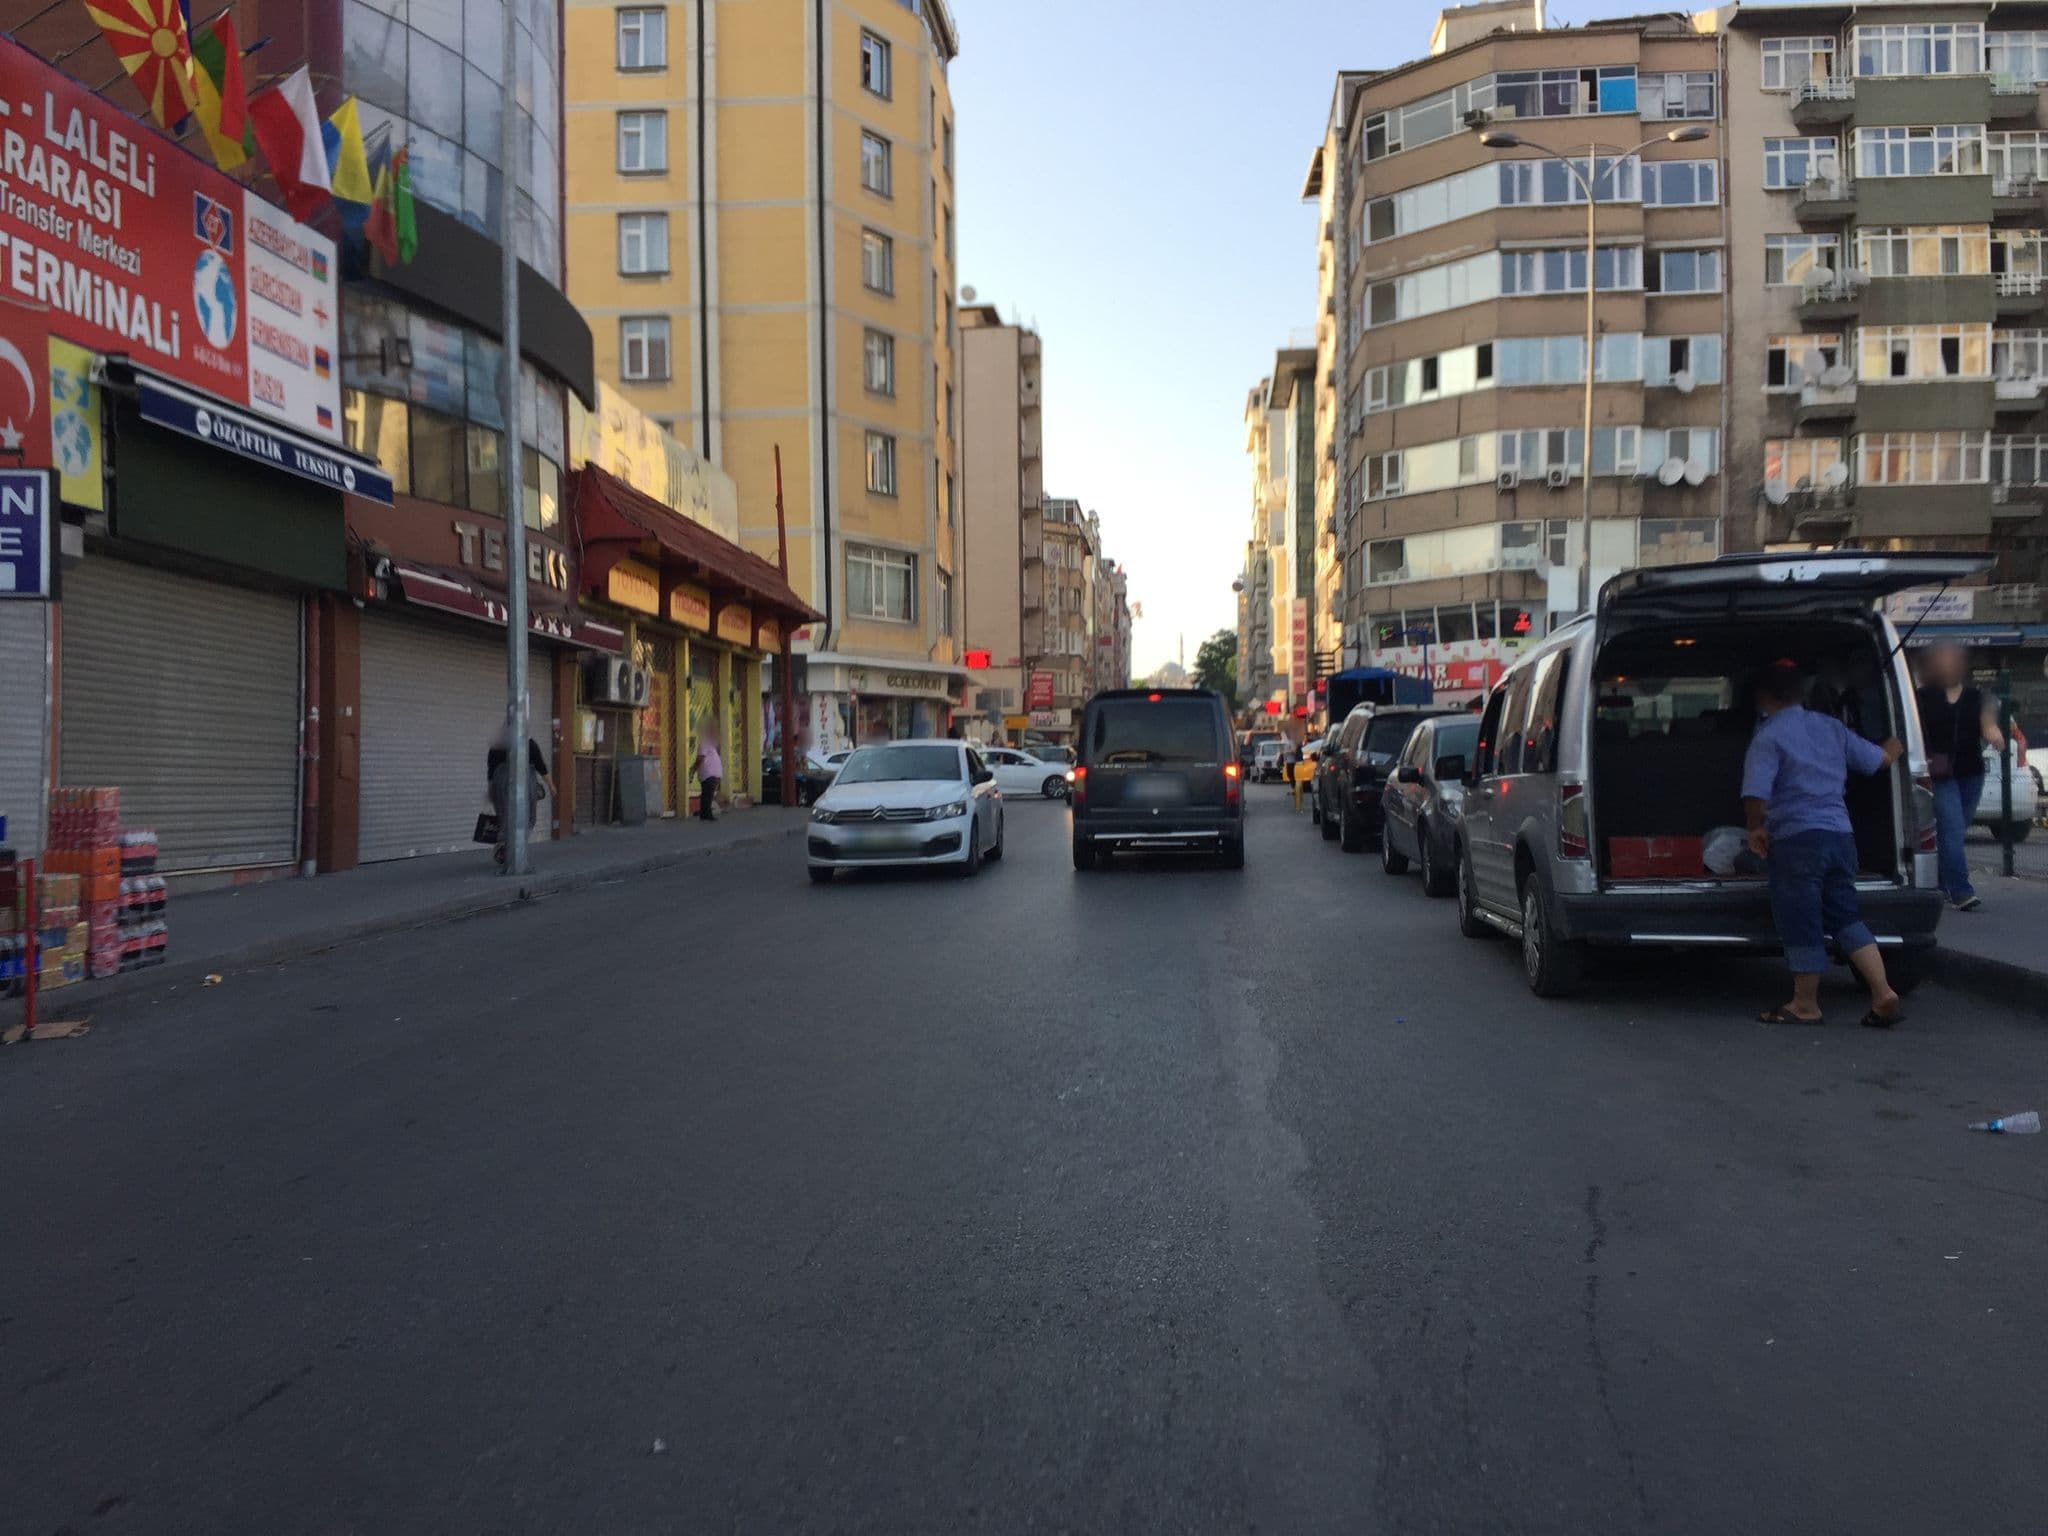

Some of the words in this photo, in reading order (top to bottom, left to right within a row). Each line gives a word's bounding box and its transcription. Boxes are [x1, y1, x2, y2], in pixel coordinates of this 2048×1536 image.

[0, 128, 121, 230] RARASI
[78, 219, 141, 276] Merkezi
[295, 450, 341, 483] TEKSTİL
